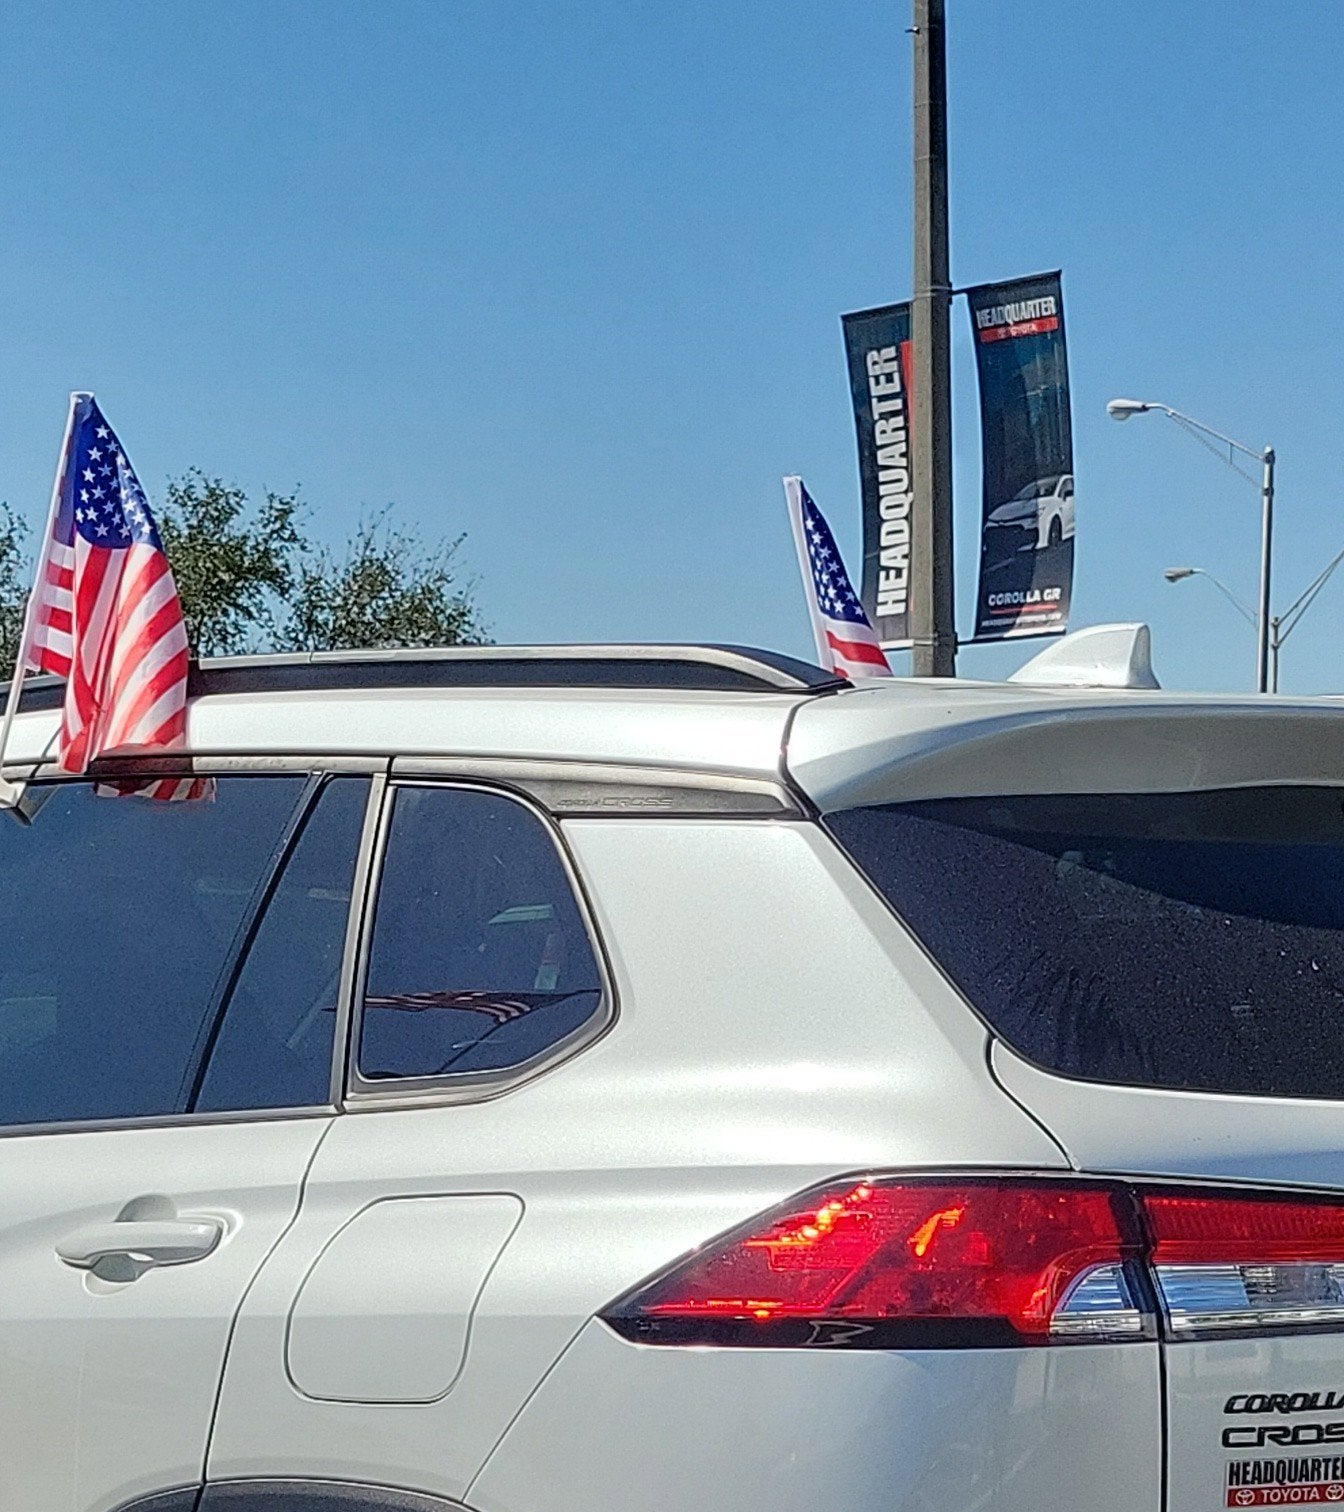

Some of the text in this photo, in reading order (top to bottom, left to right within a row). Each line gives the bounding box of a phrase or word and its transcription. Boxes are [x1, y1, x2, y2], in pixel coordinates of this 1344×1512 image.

[976, 296, 1056, 328] HEADQUARTER
[866, 346, 914, 618] HEADQUARTER
[988, 590, 1041, 606] COROLLA
[1261, 1488, 1320, 1503] TOYOTA
